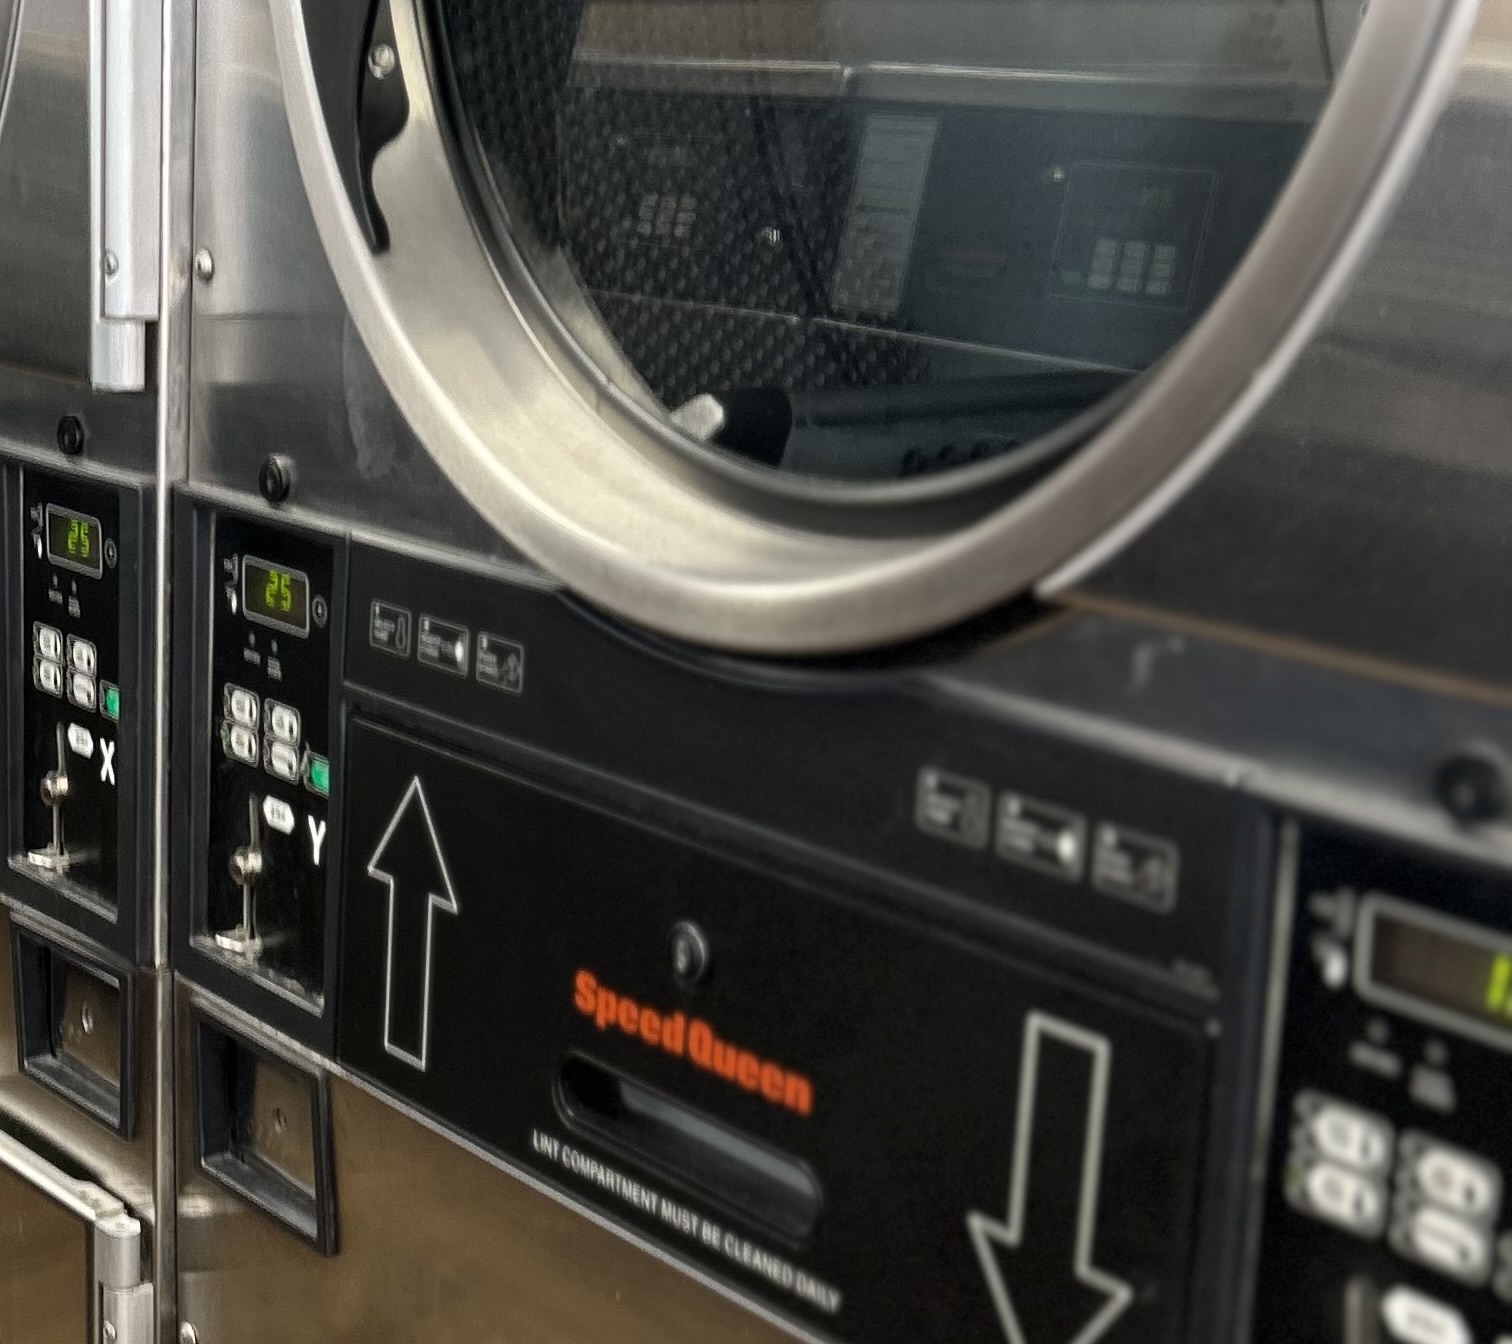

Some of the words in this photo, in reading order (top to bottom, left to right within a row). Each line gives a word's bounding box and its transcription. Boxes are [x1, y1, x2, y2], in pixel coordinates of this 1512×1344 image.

[264, 568, 292, 614] 25
[99, 736, 116, 786] X
[307, 813, 327, 867] Y
[561, 1144, 658, 1214] COMPARTMENT
[660, 1197, 699, 1238] MUST
[701, 1219, 721, 1247] BE
[723, 1231, 793, 1290] CLEANED
[795, 1260, 841, 1315] DAILY
